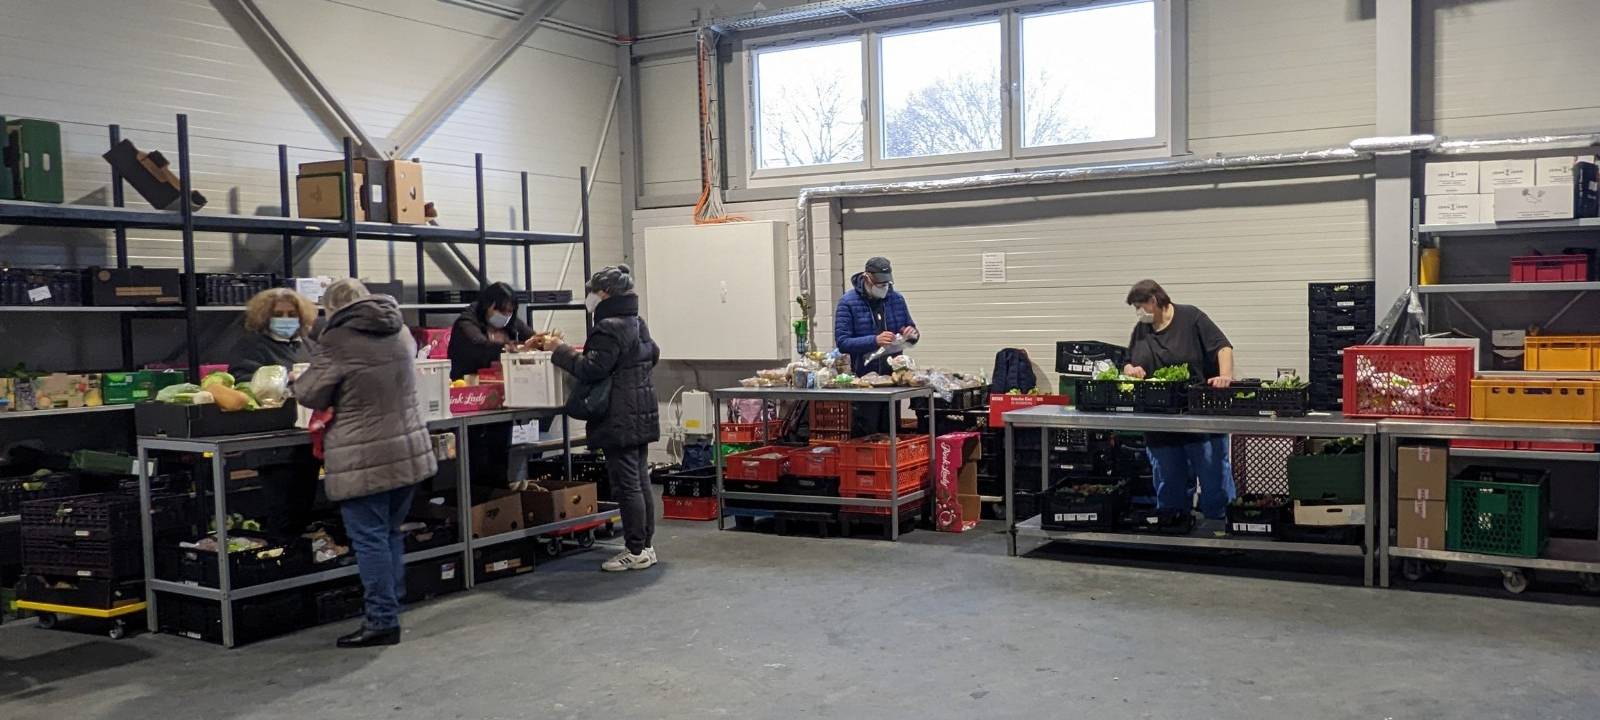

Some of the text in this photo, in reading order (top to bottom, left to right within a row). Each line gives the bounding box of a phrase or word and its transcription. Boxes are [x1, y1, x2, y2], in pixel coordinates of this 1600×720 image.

[450, 393, 486, 405] ink Lady
[940, 443, 950, 486] Pink Lady
